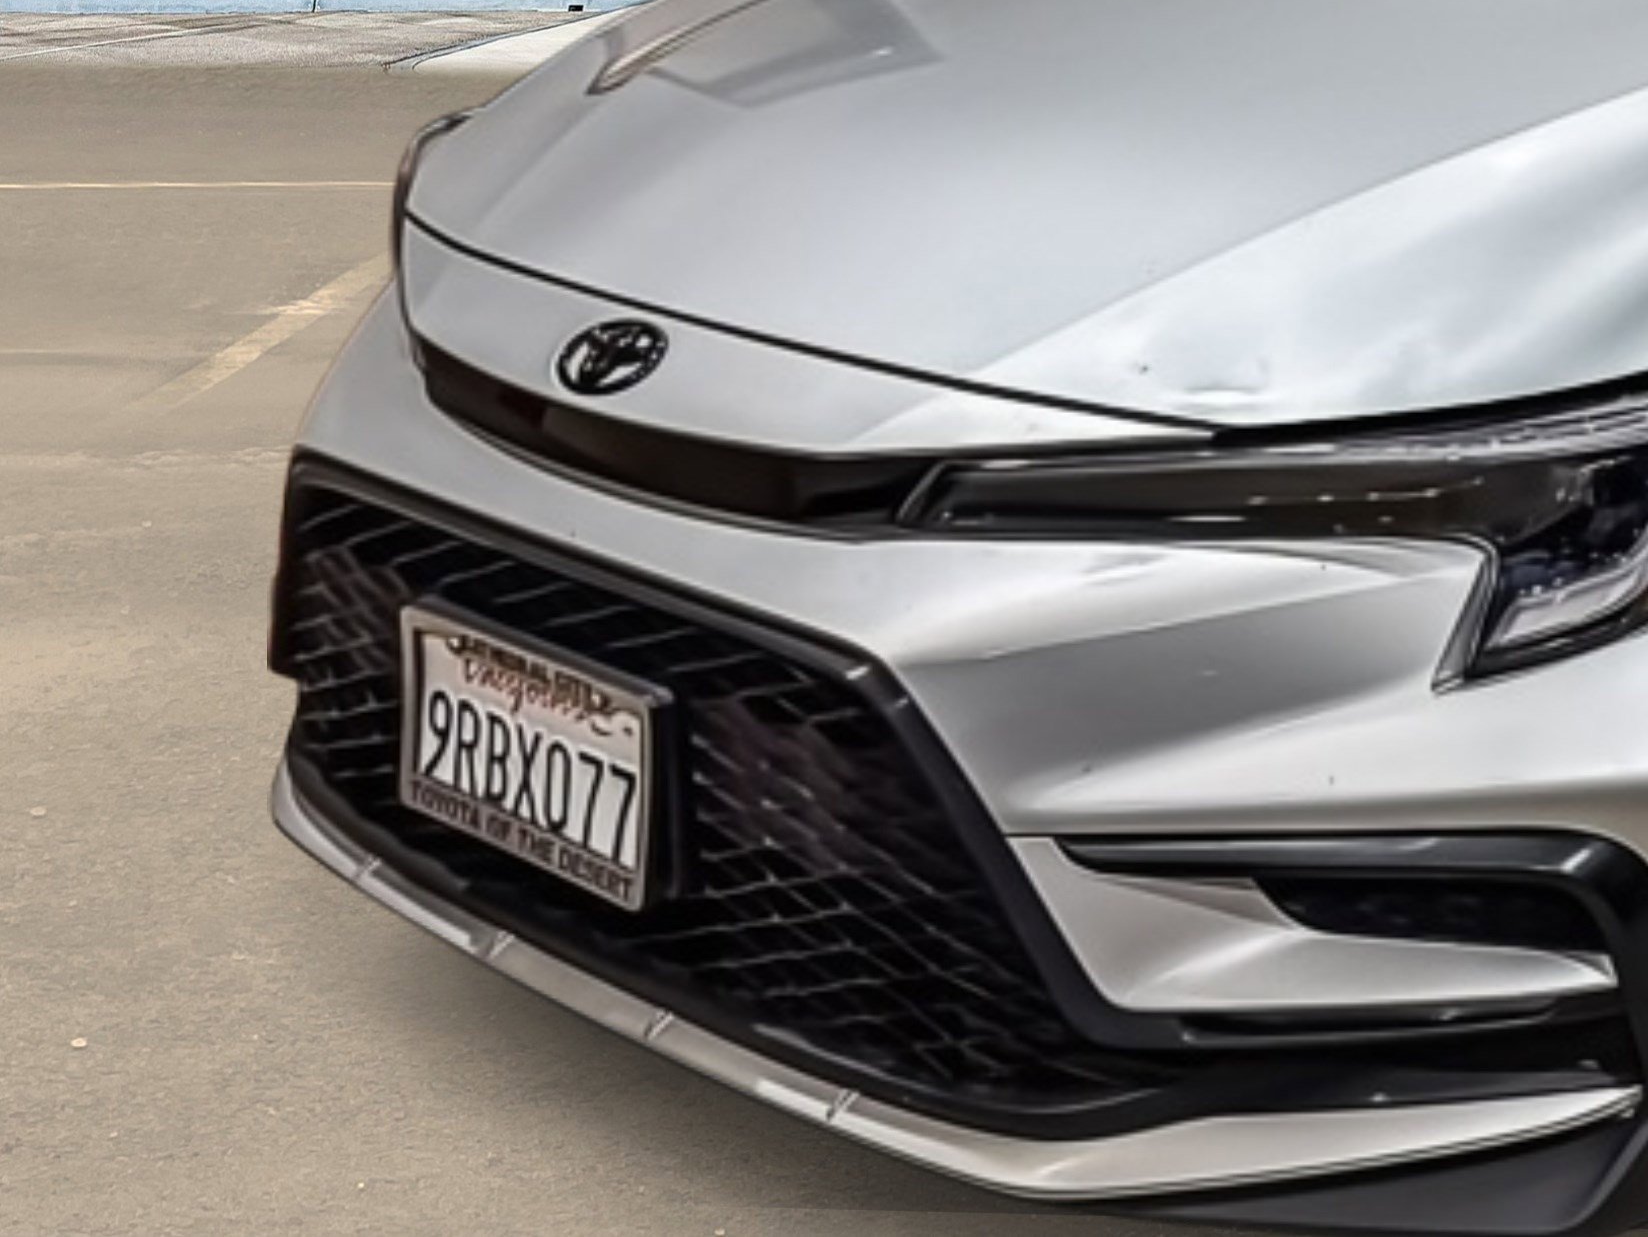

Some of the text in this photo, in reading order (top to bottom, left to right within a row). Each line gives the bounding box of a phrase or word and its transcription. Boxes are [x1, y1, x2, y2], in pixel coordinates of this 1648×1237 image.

[411, 779, 633, 902] TOYOTA OF THE DESERT
[424, 689, 637, 865] 9RBX077
